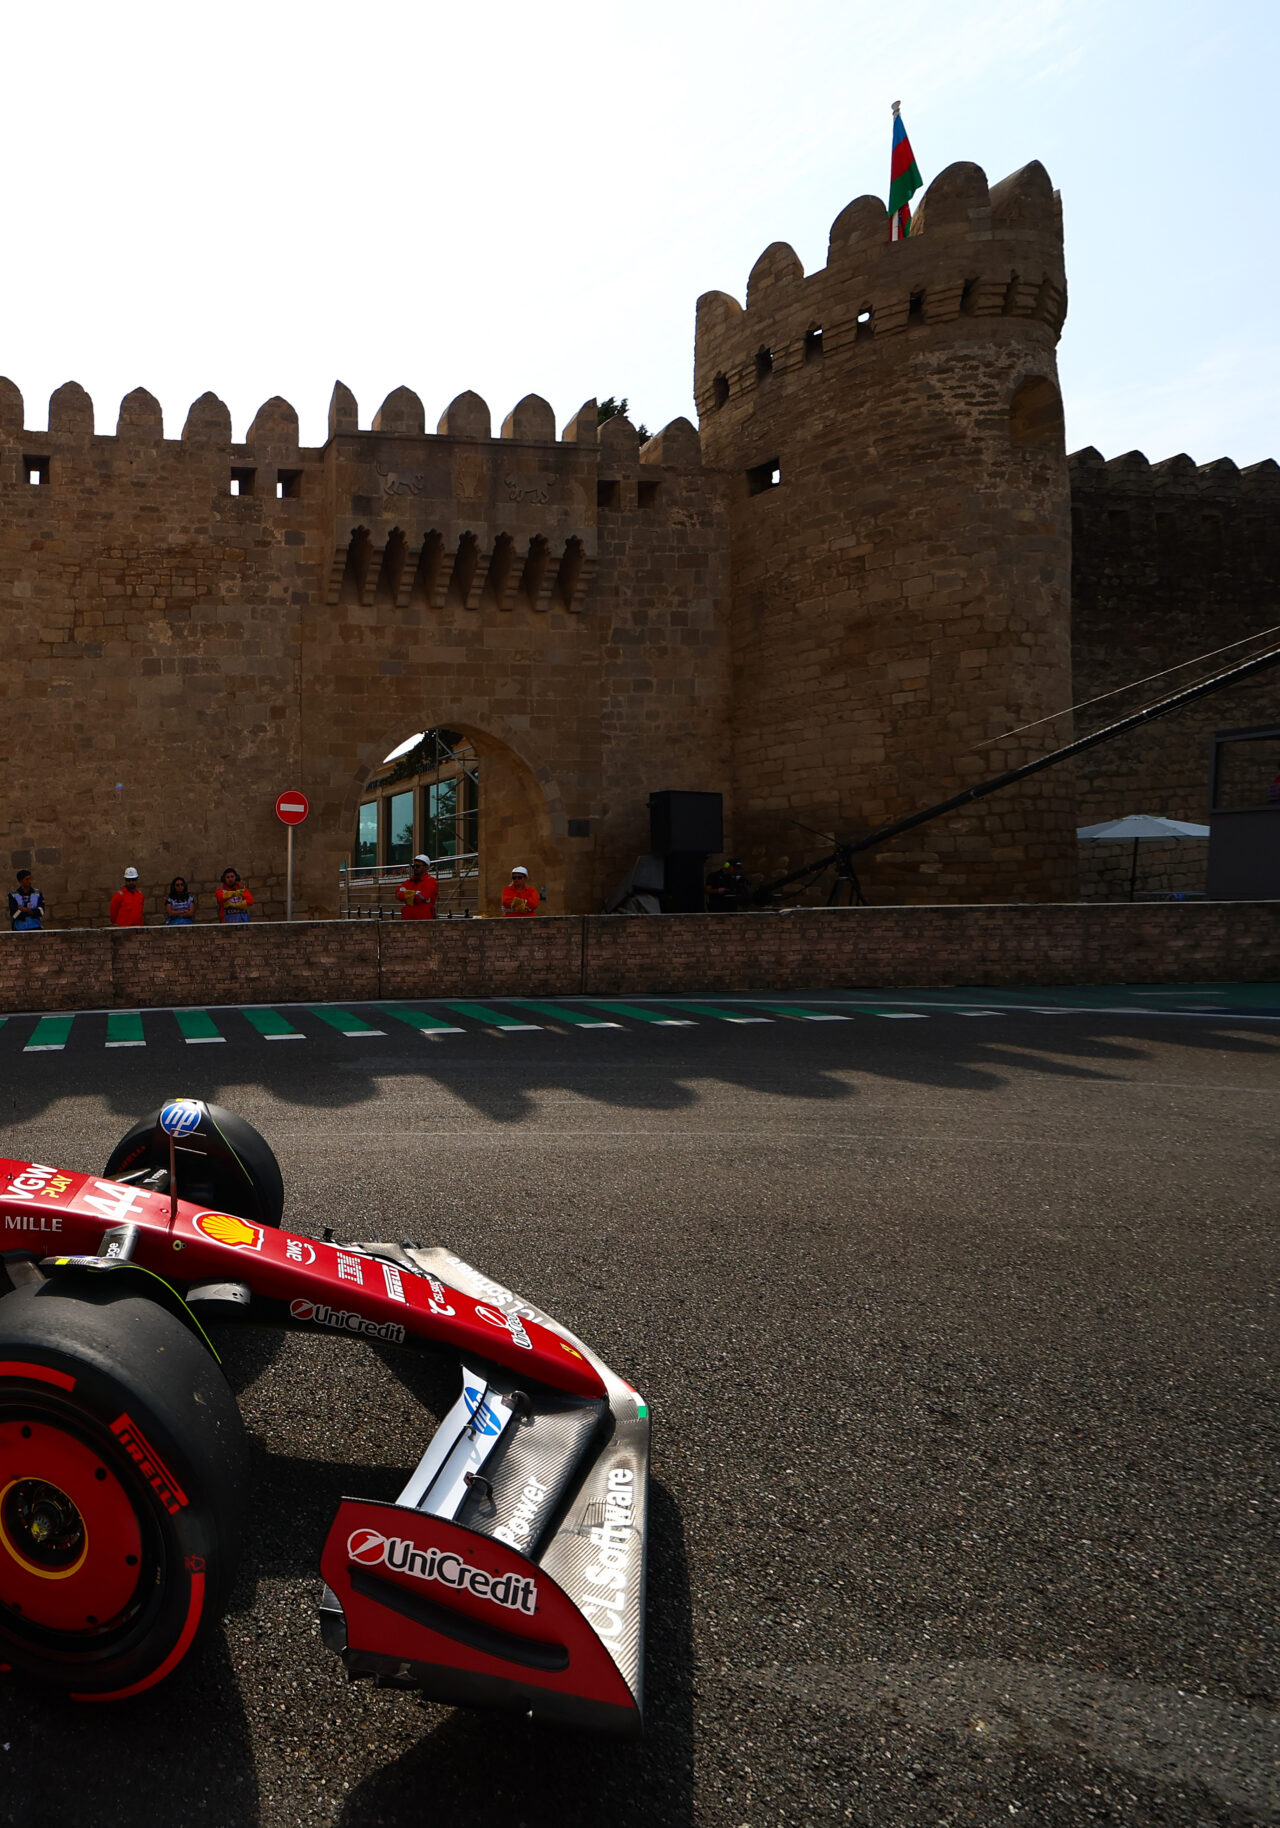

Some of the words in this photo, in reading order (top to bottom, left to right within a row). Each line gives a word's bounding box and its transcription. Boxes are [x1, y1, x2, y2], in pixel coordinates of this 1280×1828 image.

[167, 1102, 199, 1136] hp
[83, 1181, 152, 1219] 44
[4, 1216, 63, 1233] MILLE
[286, 1239, 303, 1262] aws
[336, 1251, 364, 1285] IBM
[382, 1263, 406, 1303] PIRELLI
[314, 1302, 404, 1344] UniCredit
[109, 1412, 189, 1515] PIRELLI
[384, 1536, 539, 1616] UniCredit
